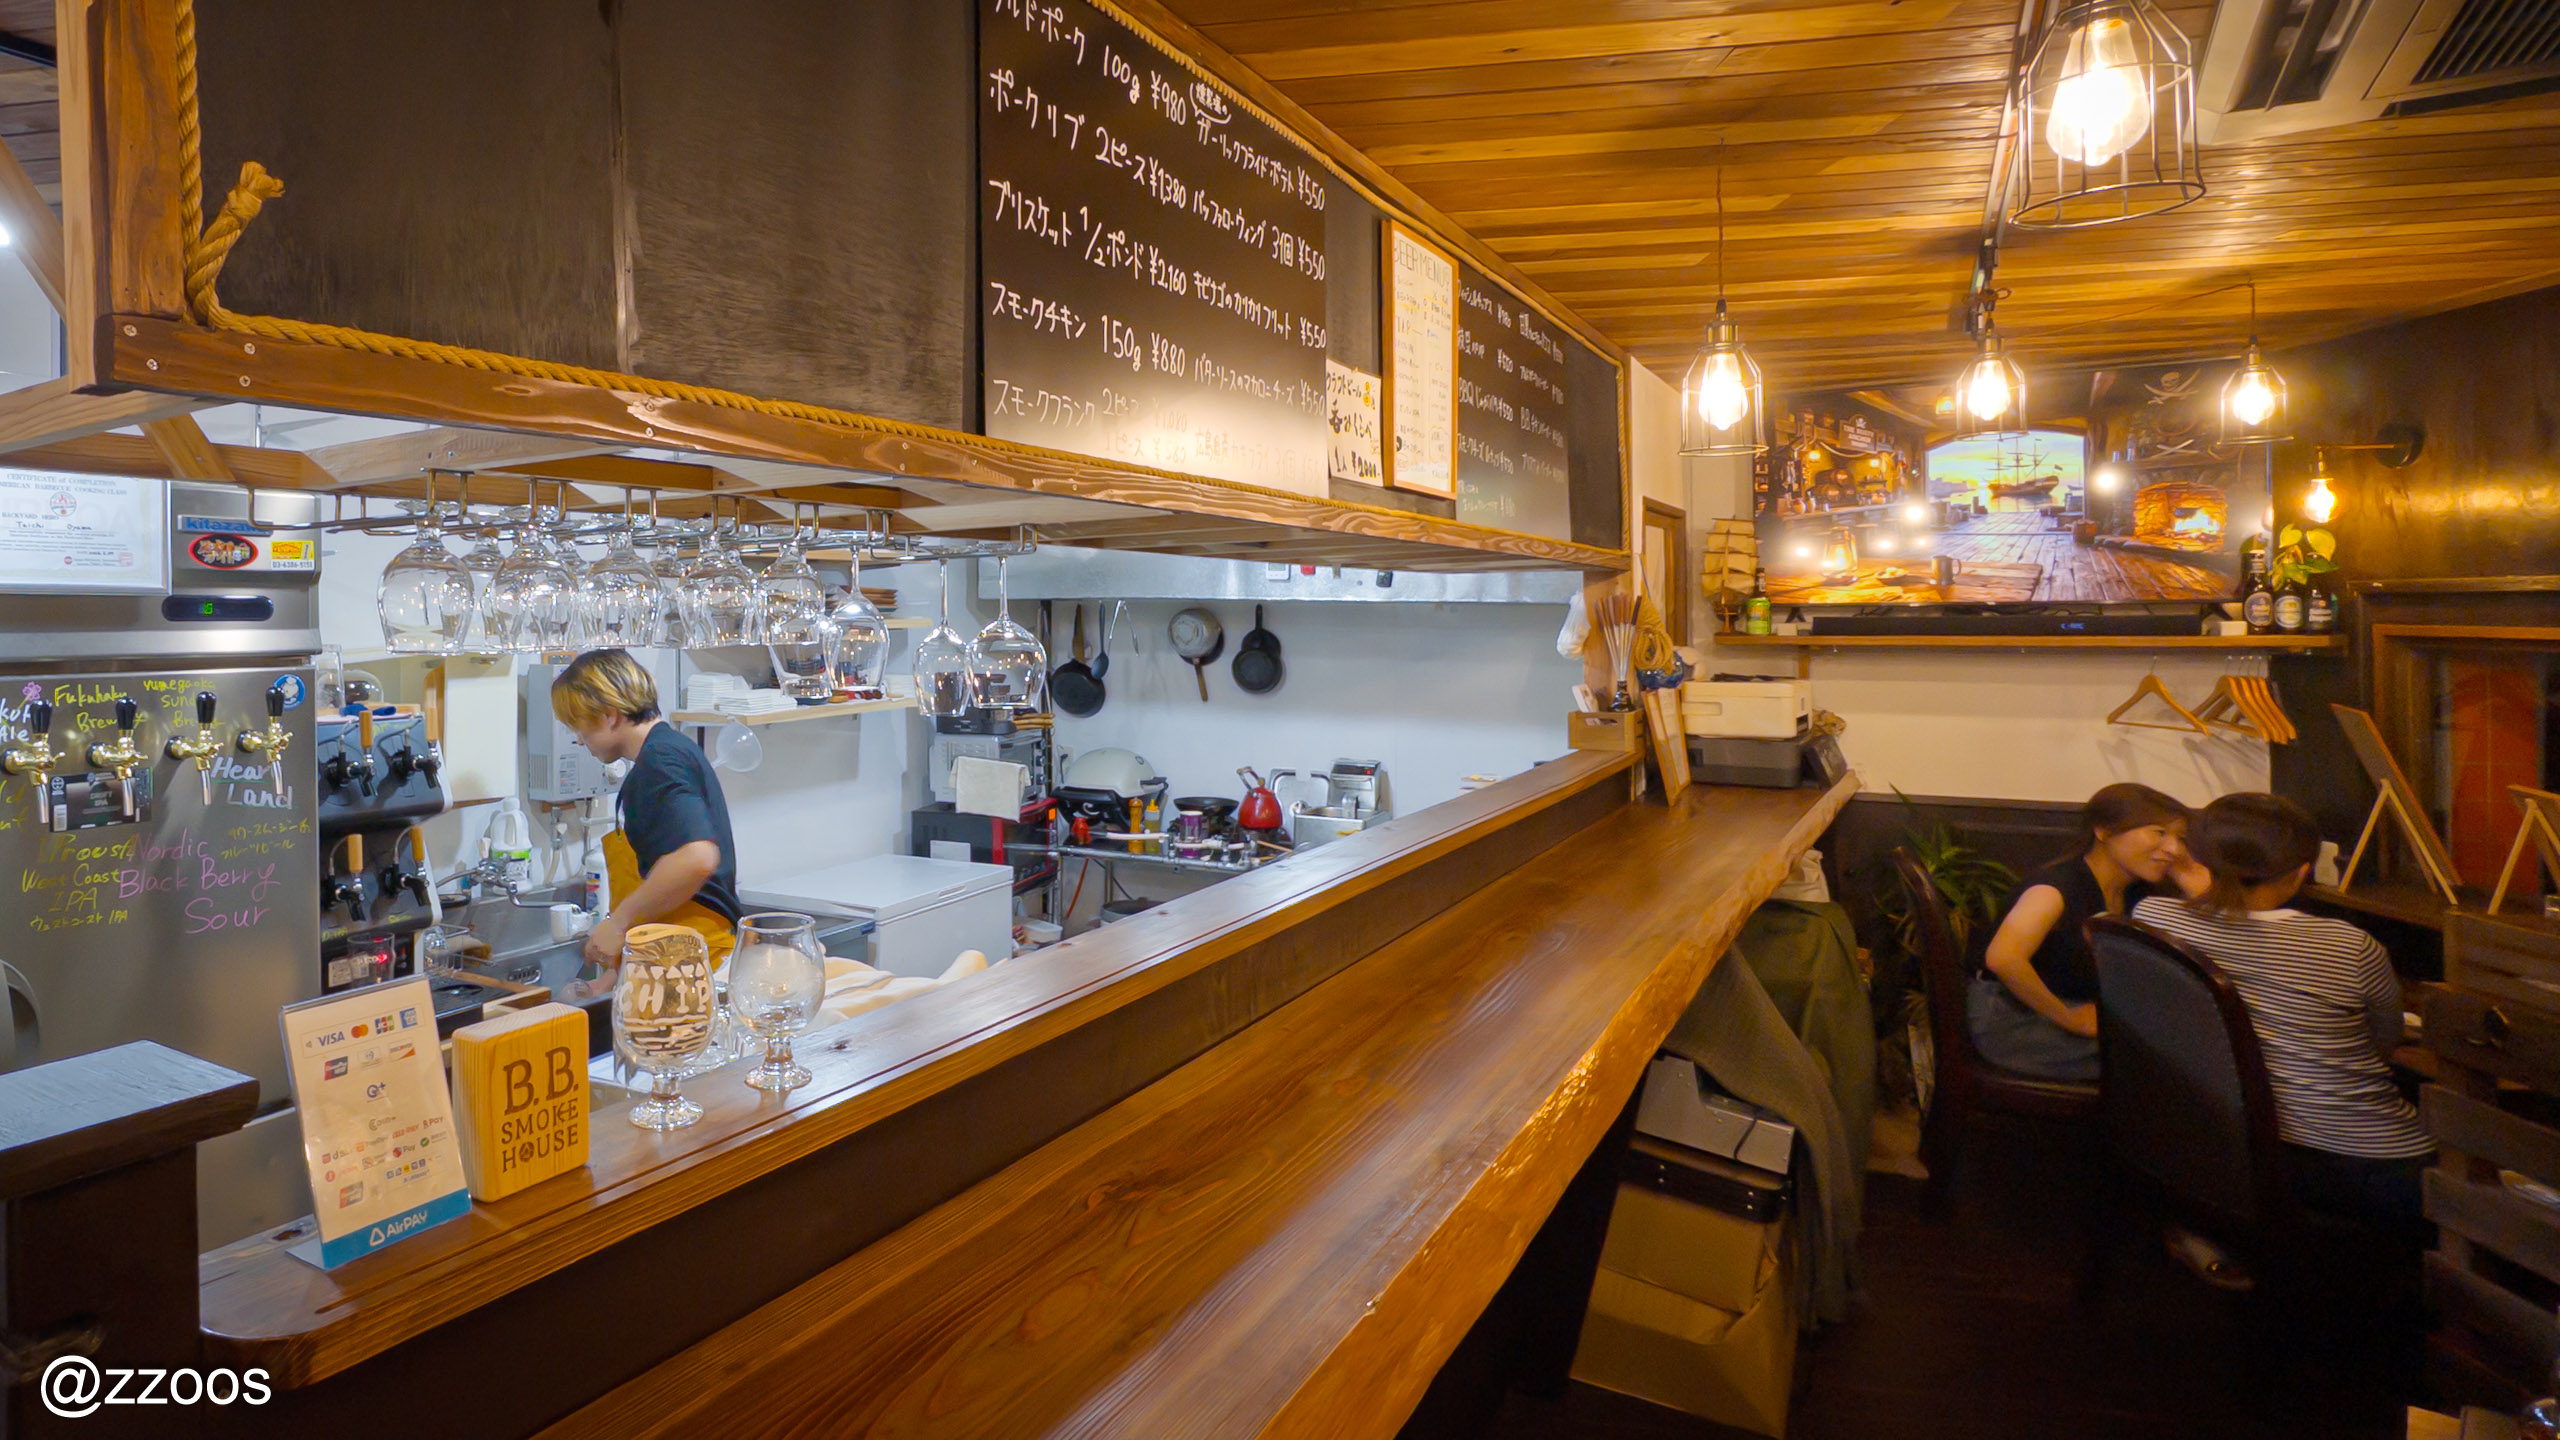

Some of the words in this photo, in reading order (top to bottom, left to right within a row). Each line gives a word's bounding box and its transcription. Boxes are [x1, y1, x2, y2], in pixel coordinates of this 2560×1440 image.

[995, 0, 1085, 66] ルドポーク
[1103, 45, 1140, 105] 100g
[1150, 69, 1187, 126] ¥980
[989, 68, 1085, 151] ポークリブ
[1095, 126, 1145, 186] 2ピース
[1298, 165, 1325, 211] ¥550
[989, 180, 1073, 247] ブリスケット
[1271, 225, 1294, 268] 3個
[1298, 236, 1326, 281] ¥550
[991, 281, 1087, 339] スモークチキン
[1101, 315, 1142, 371] 150g
[1151, 333, 1186, 378] ¥880
[1300, 316, 1327, 349] ¥550
[993, 379, 1095, 428] スモークフランク
[1301, 378, 1325, 417] ¥550
[7, 473, 56, 483] CERTIFICATE
[211, 756, 274, 780] Hear
[227, 783, 293, 810] Land
[48, 887, 98, 912] IPA
[119, 866, 189, 899] Black
[201, 856, 281, 902] Berry
[184, 897, 271, 934] Sour
[317, 1031, 346, 1046] VISA
[502, 1046, 579, 1116] B.B.
[502, 1098, 578, 1145] SMOKE
[502, 1122, 578, 1173] HOUSE
[387, 1209, 428, 1238] AirPAY
